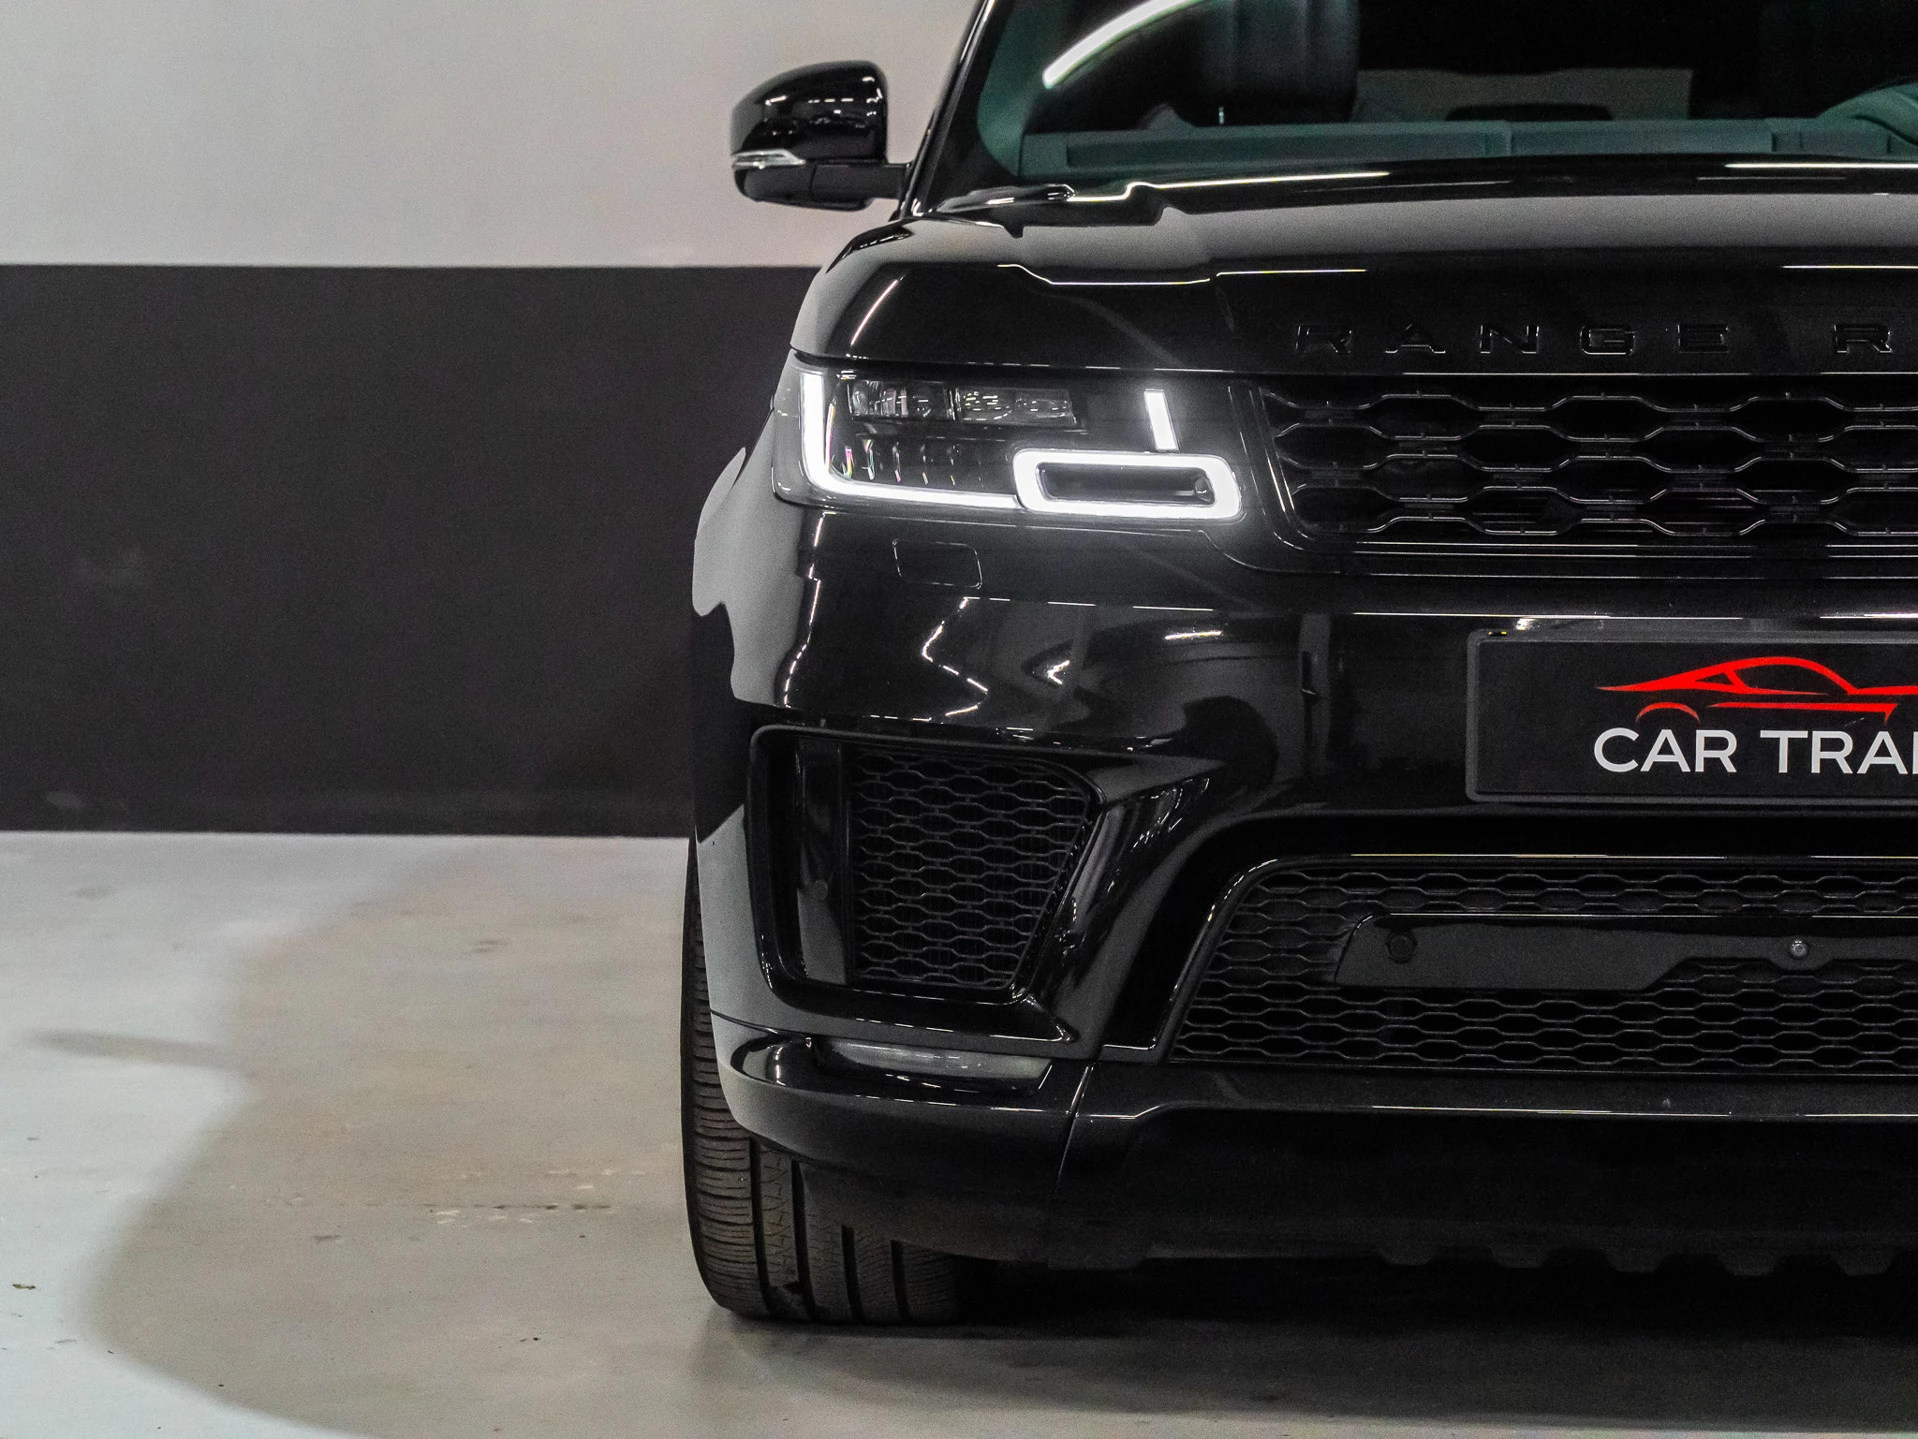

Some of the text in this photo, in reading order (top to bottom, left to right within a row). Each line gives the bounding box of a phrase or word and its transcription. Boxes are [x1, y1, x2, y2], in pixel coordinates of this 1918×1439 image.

[1295, 323, 1730, 356] RANGE
[1593, 727, 1918, 775] CAR TRA
